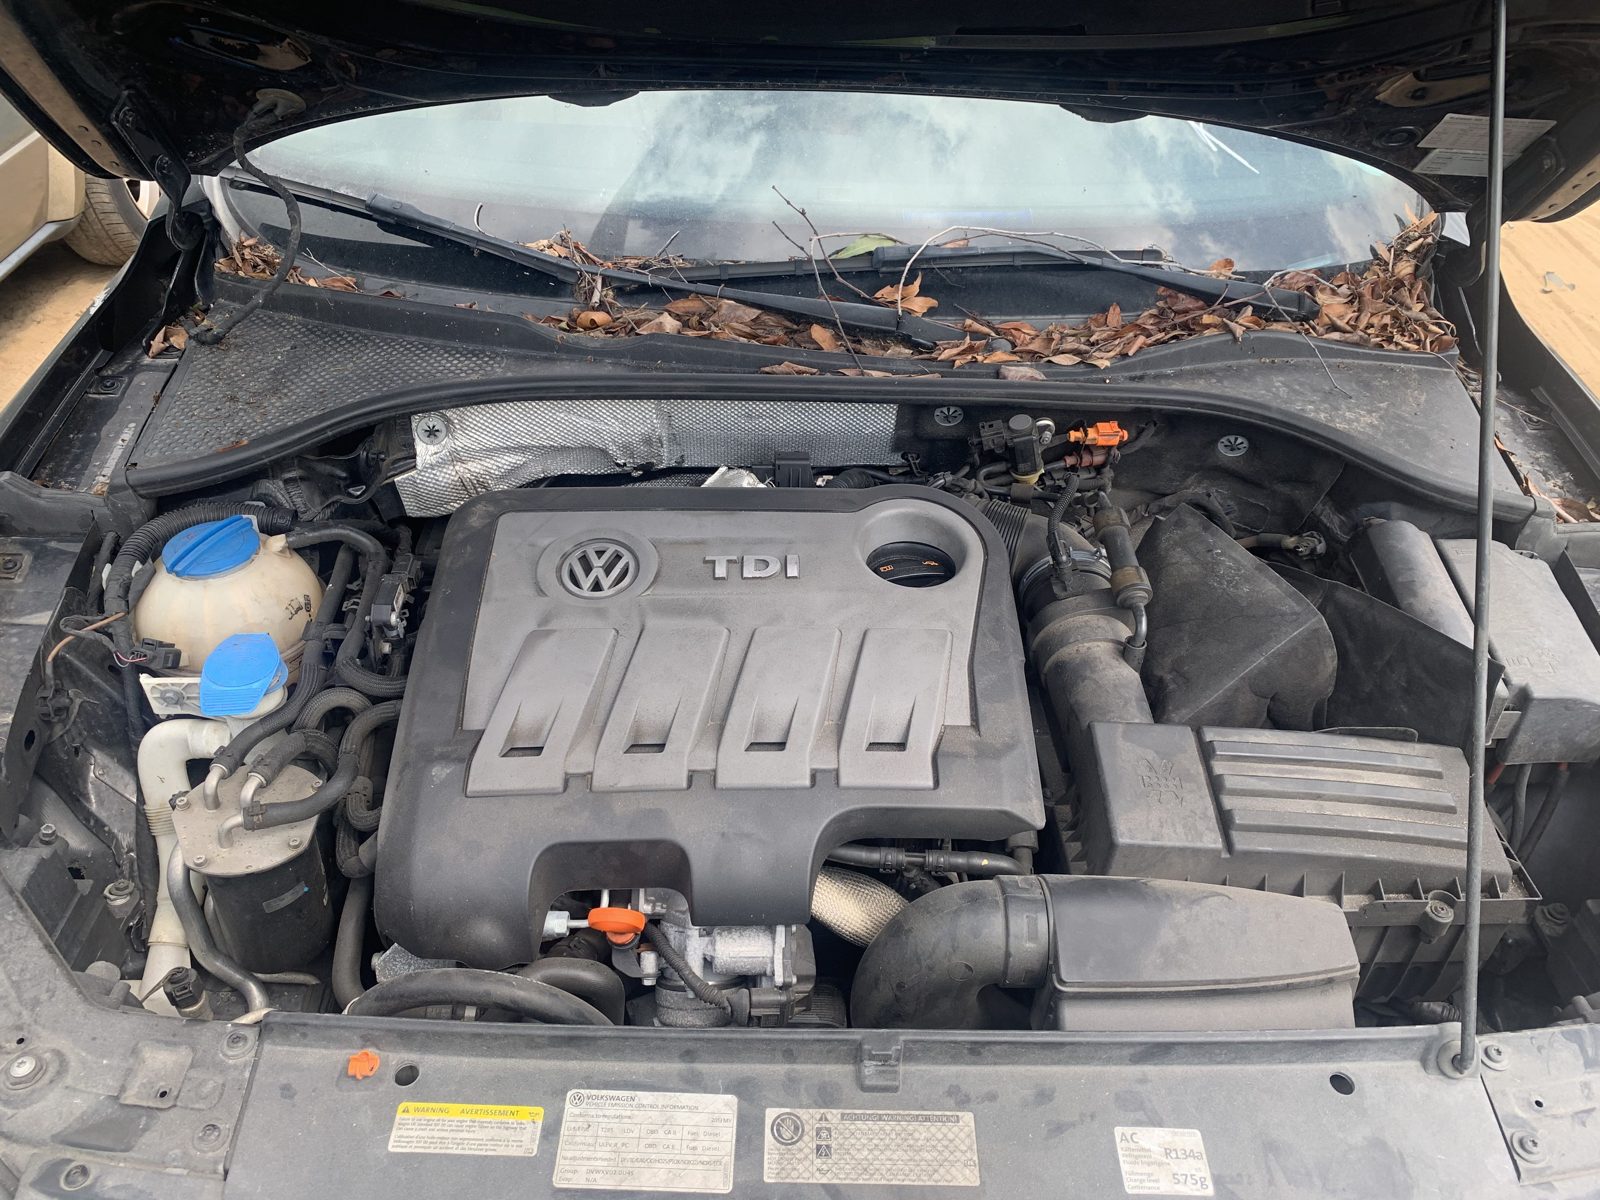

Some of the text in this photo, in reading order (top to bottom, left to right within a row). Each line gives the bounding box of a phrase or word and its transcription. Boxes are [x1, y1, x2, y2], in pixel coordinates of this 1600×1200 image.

[704, 554, 800, 581] TDI
[586, 1094, 636, 1103] VOLKSWAGEN
[413, 1107, 520, 1117] WARNING AVERTISSEMENT
[1120, 1131, 1139, 1144] AC
[1163, 1147, 1204, 1160] R134a
[1172, 1172, 1209, 1190] 575g
